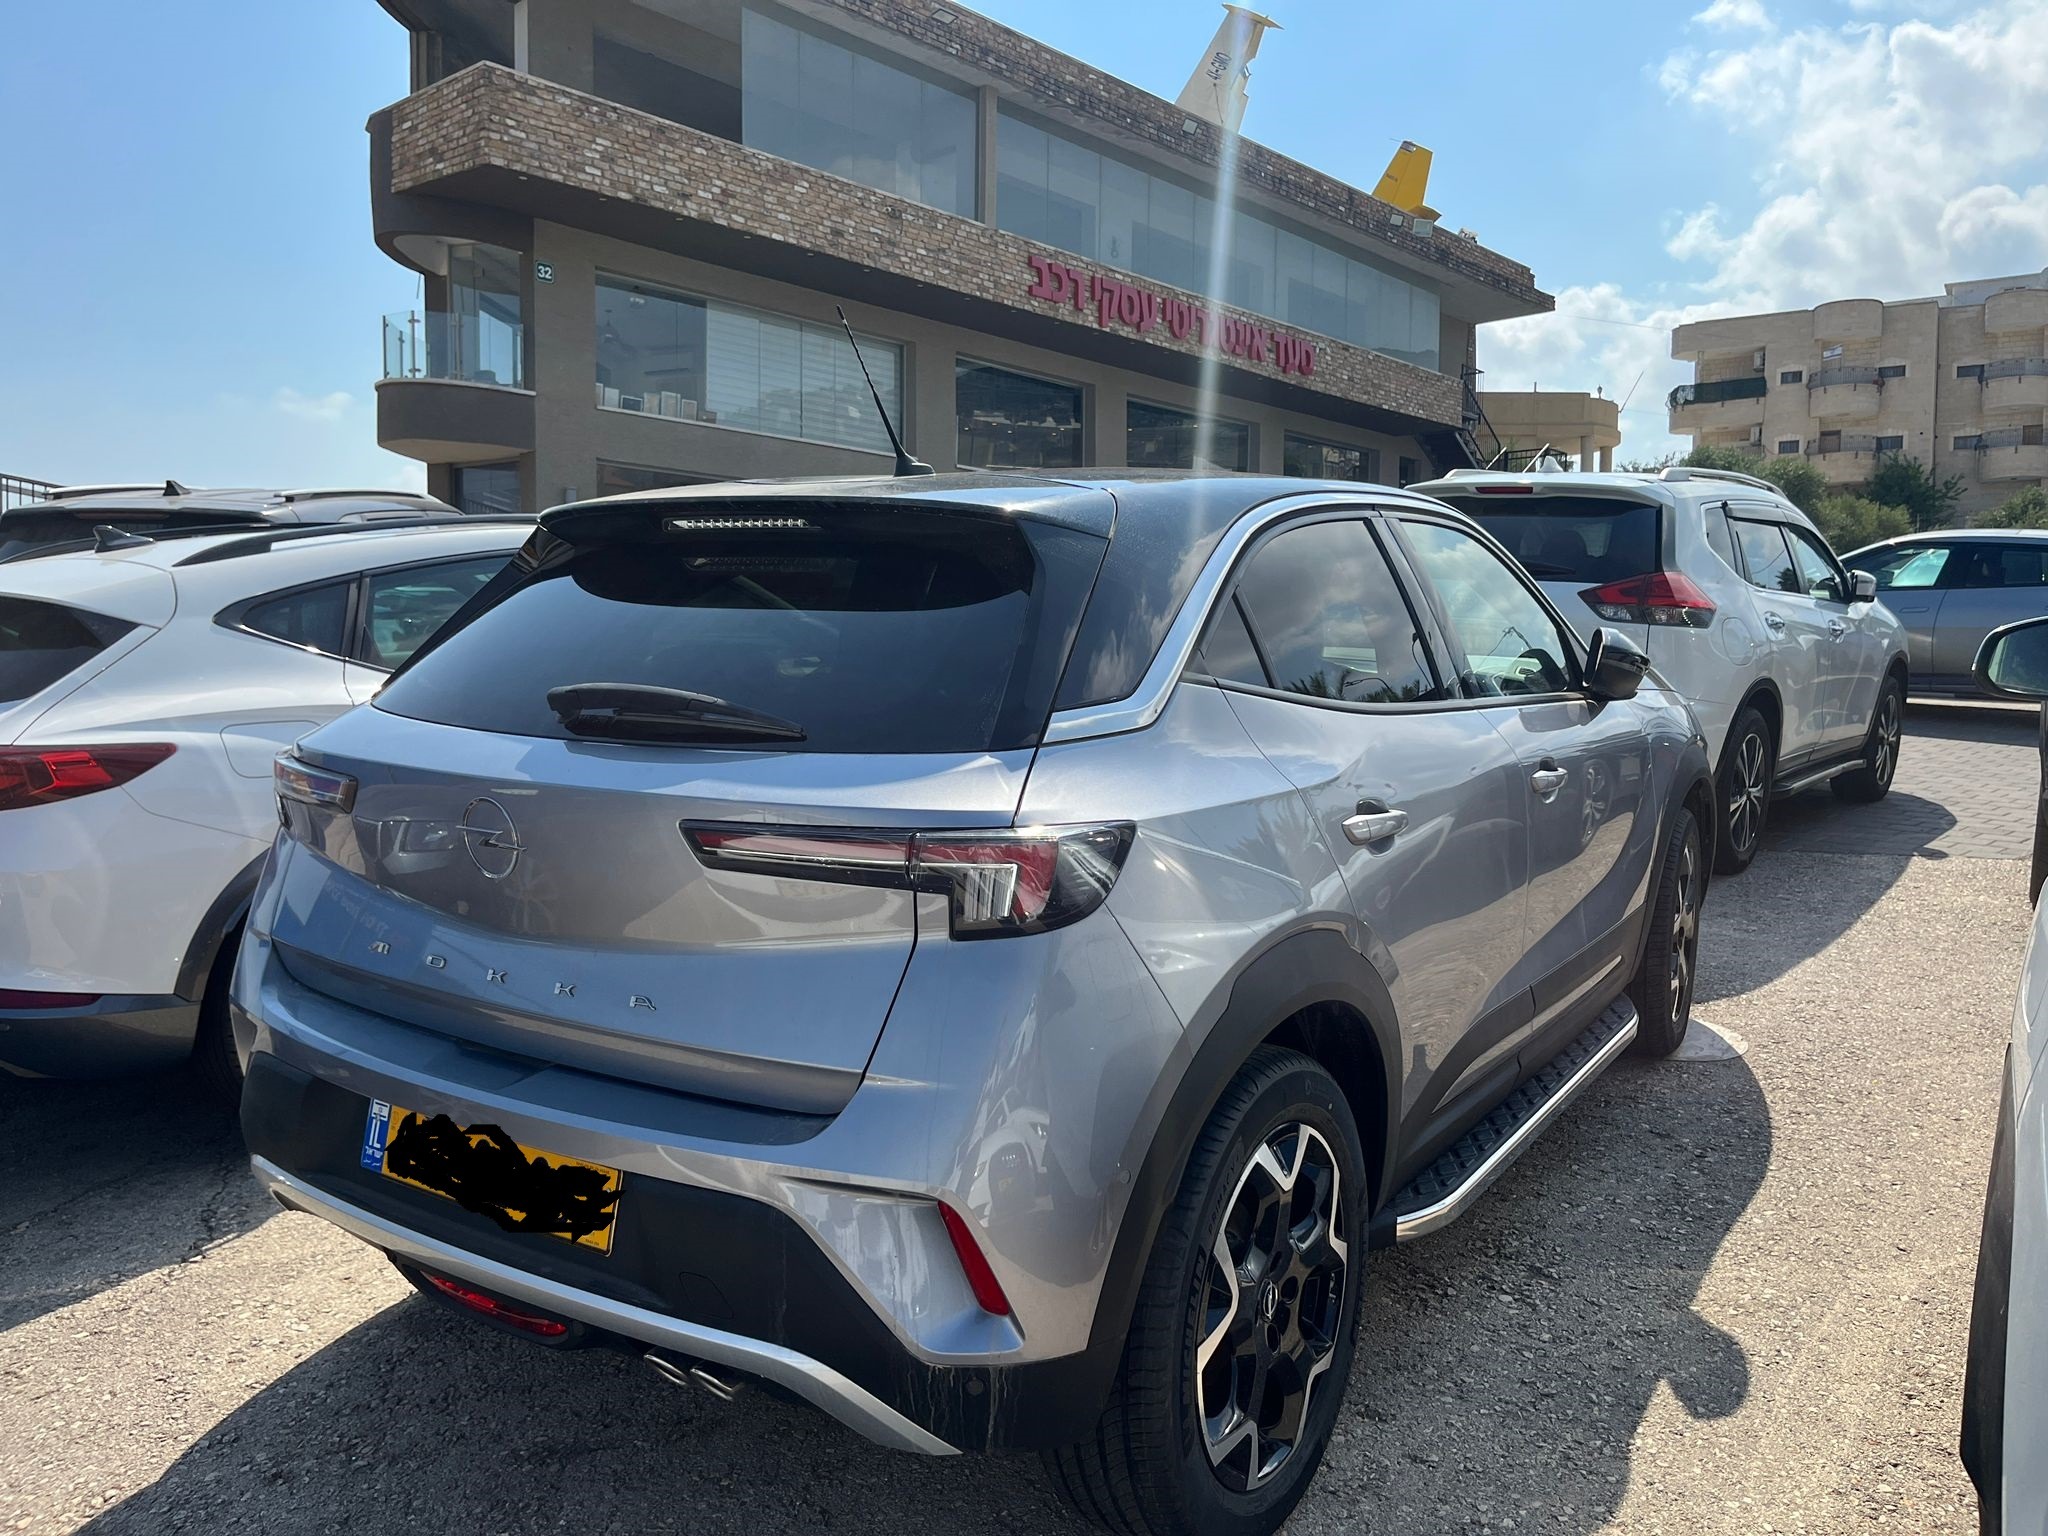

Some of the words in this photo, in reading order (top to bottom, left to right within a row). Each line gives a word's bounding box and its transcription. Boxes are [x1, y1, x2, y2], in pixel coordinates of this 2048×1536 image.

[537, 265, 552, 279] 32
[1028, 255, 1085, 310] רכב
[1091, 275, 1158, 332] עסקי
[1271, 332, 1315, 376] סעד
[368, 939, 658, 1011] MOKKA
